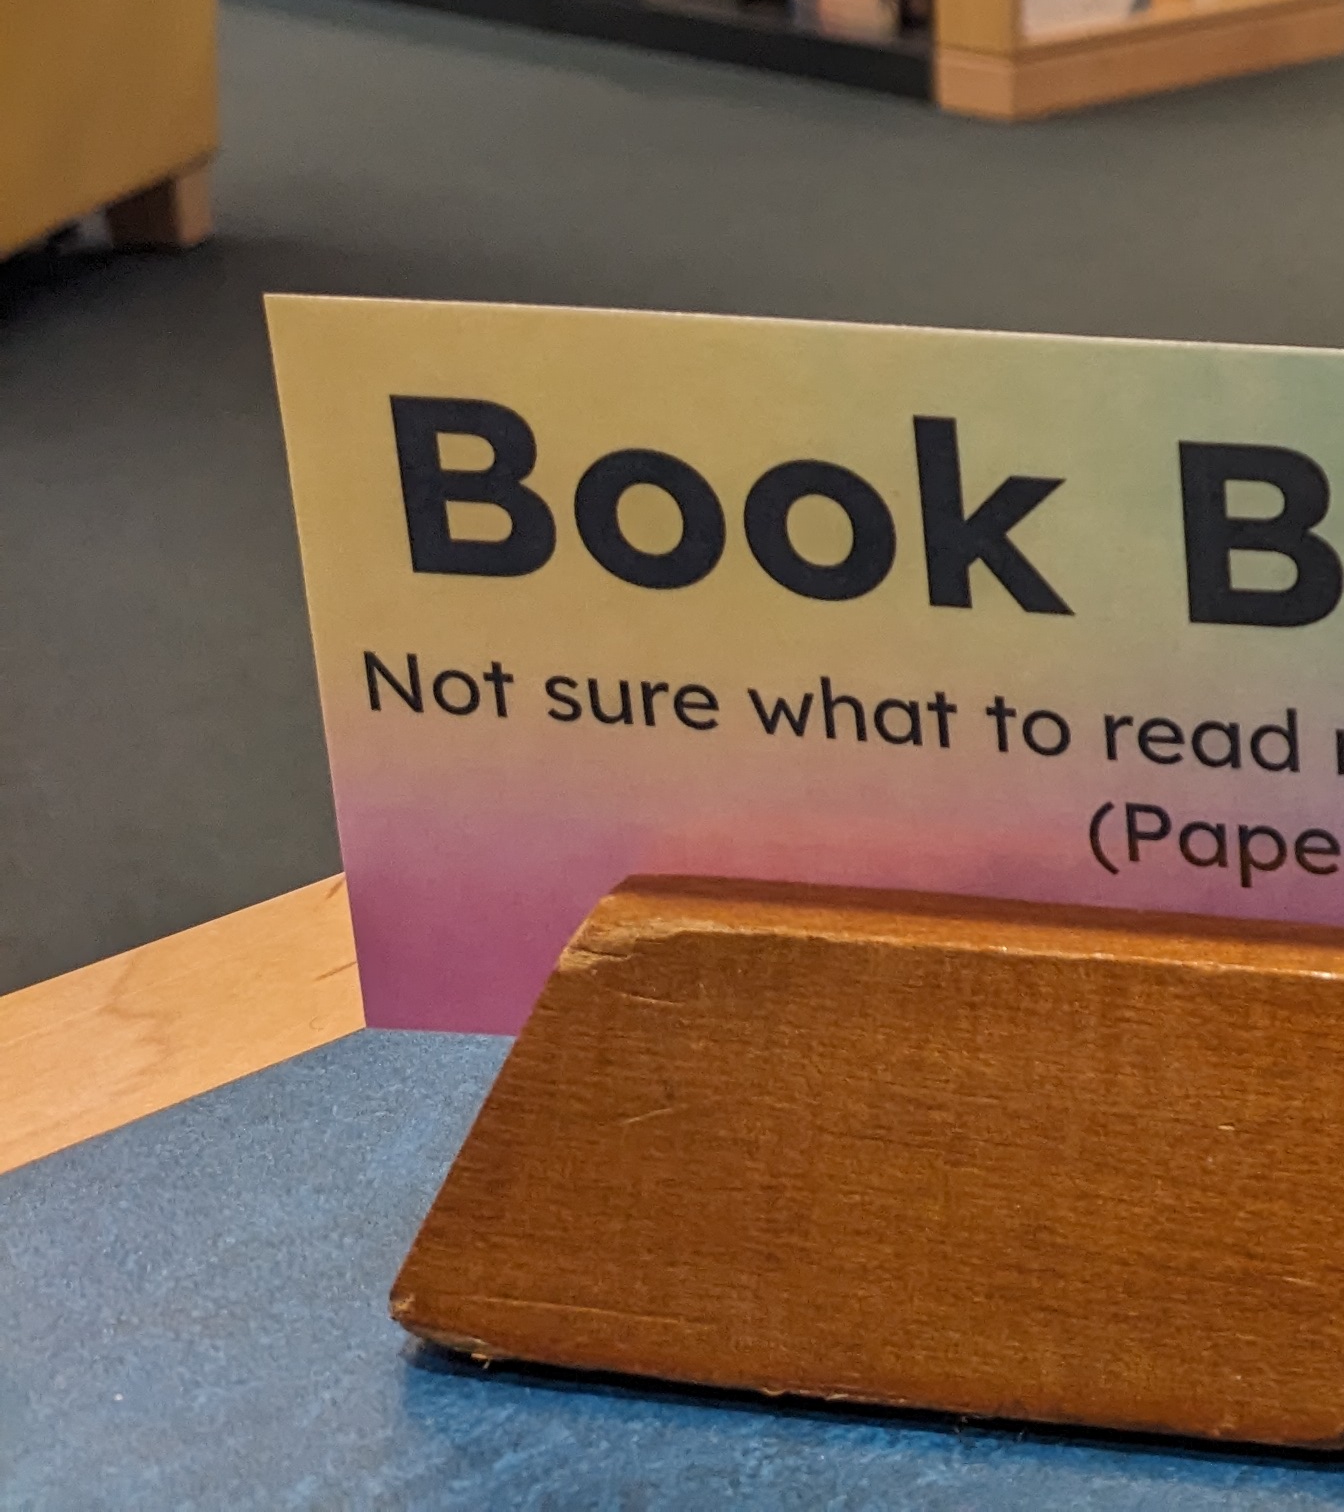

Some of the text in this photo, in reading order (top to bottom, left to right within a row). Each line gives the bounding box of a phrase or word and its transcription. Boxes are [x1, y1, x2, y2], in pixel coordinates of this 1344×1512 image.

[389, 392, 1075, 620] Book
[362, 650, 516, 719] Not
[543, 668, 719, 735] sure
[748, 678, 960, 751] what
[985, 696, 1072, 760] to
[1102, 707, 1302, 775] read
